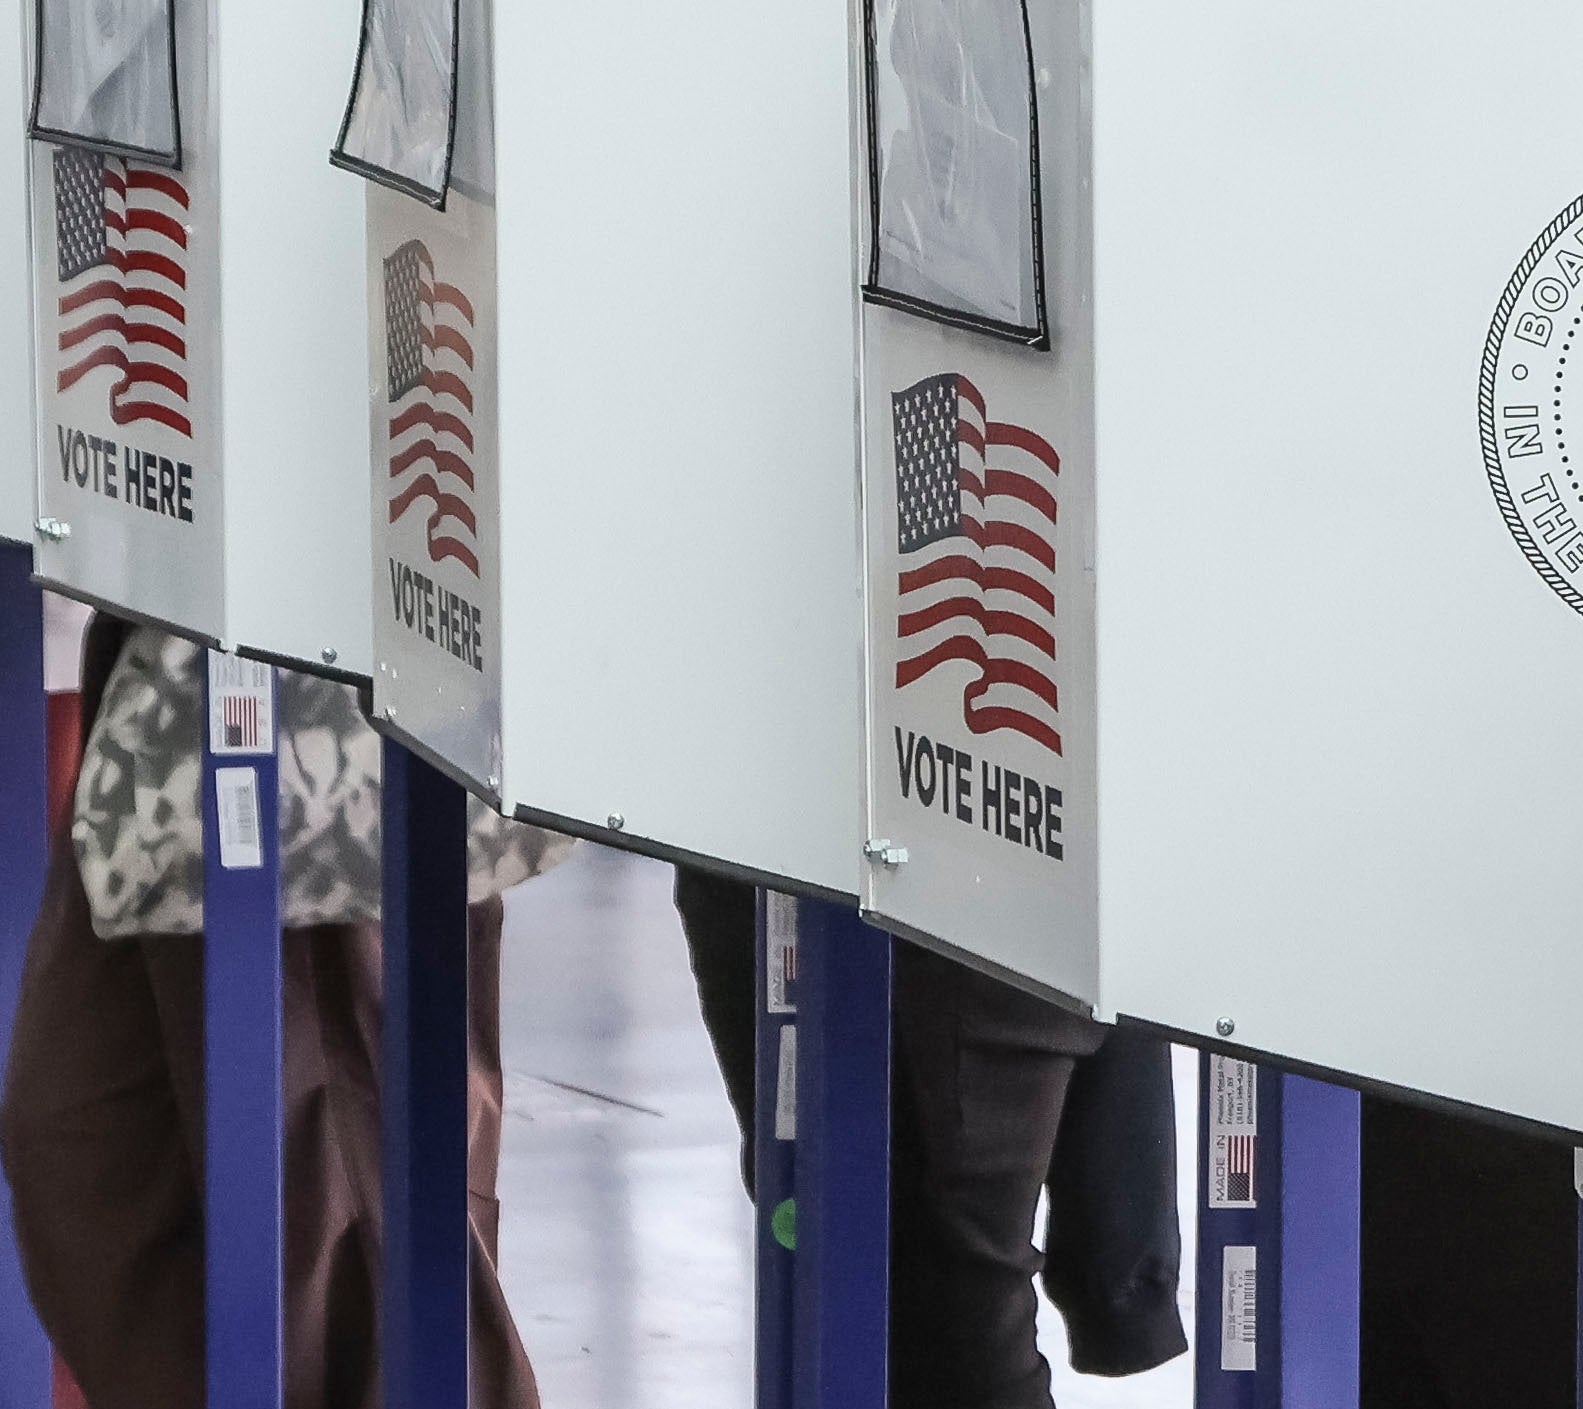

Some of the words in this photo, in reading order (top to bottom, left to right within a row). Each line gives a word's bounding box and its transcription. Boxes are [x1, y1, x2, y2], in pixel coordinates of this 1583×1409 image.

[1504, 405, 1543, 459] IN
[57, 424, 118, 499] VOTE
[124, 446, 193, 524] HERE
[389, 557, 435, 642] VOTE
[438, 585, 483, 672] HERE
[895, 725, 973, 824] VOTE
[981, 760, 1064, 861] HERE
[1216, 1135, 1226, 1149] IN
[1216, 1157, 1225, 1201] MADE
